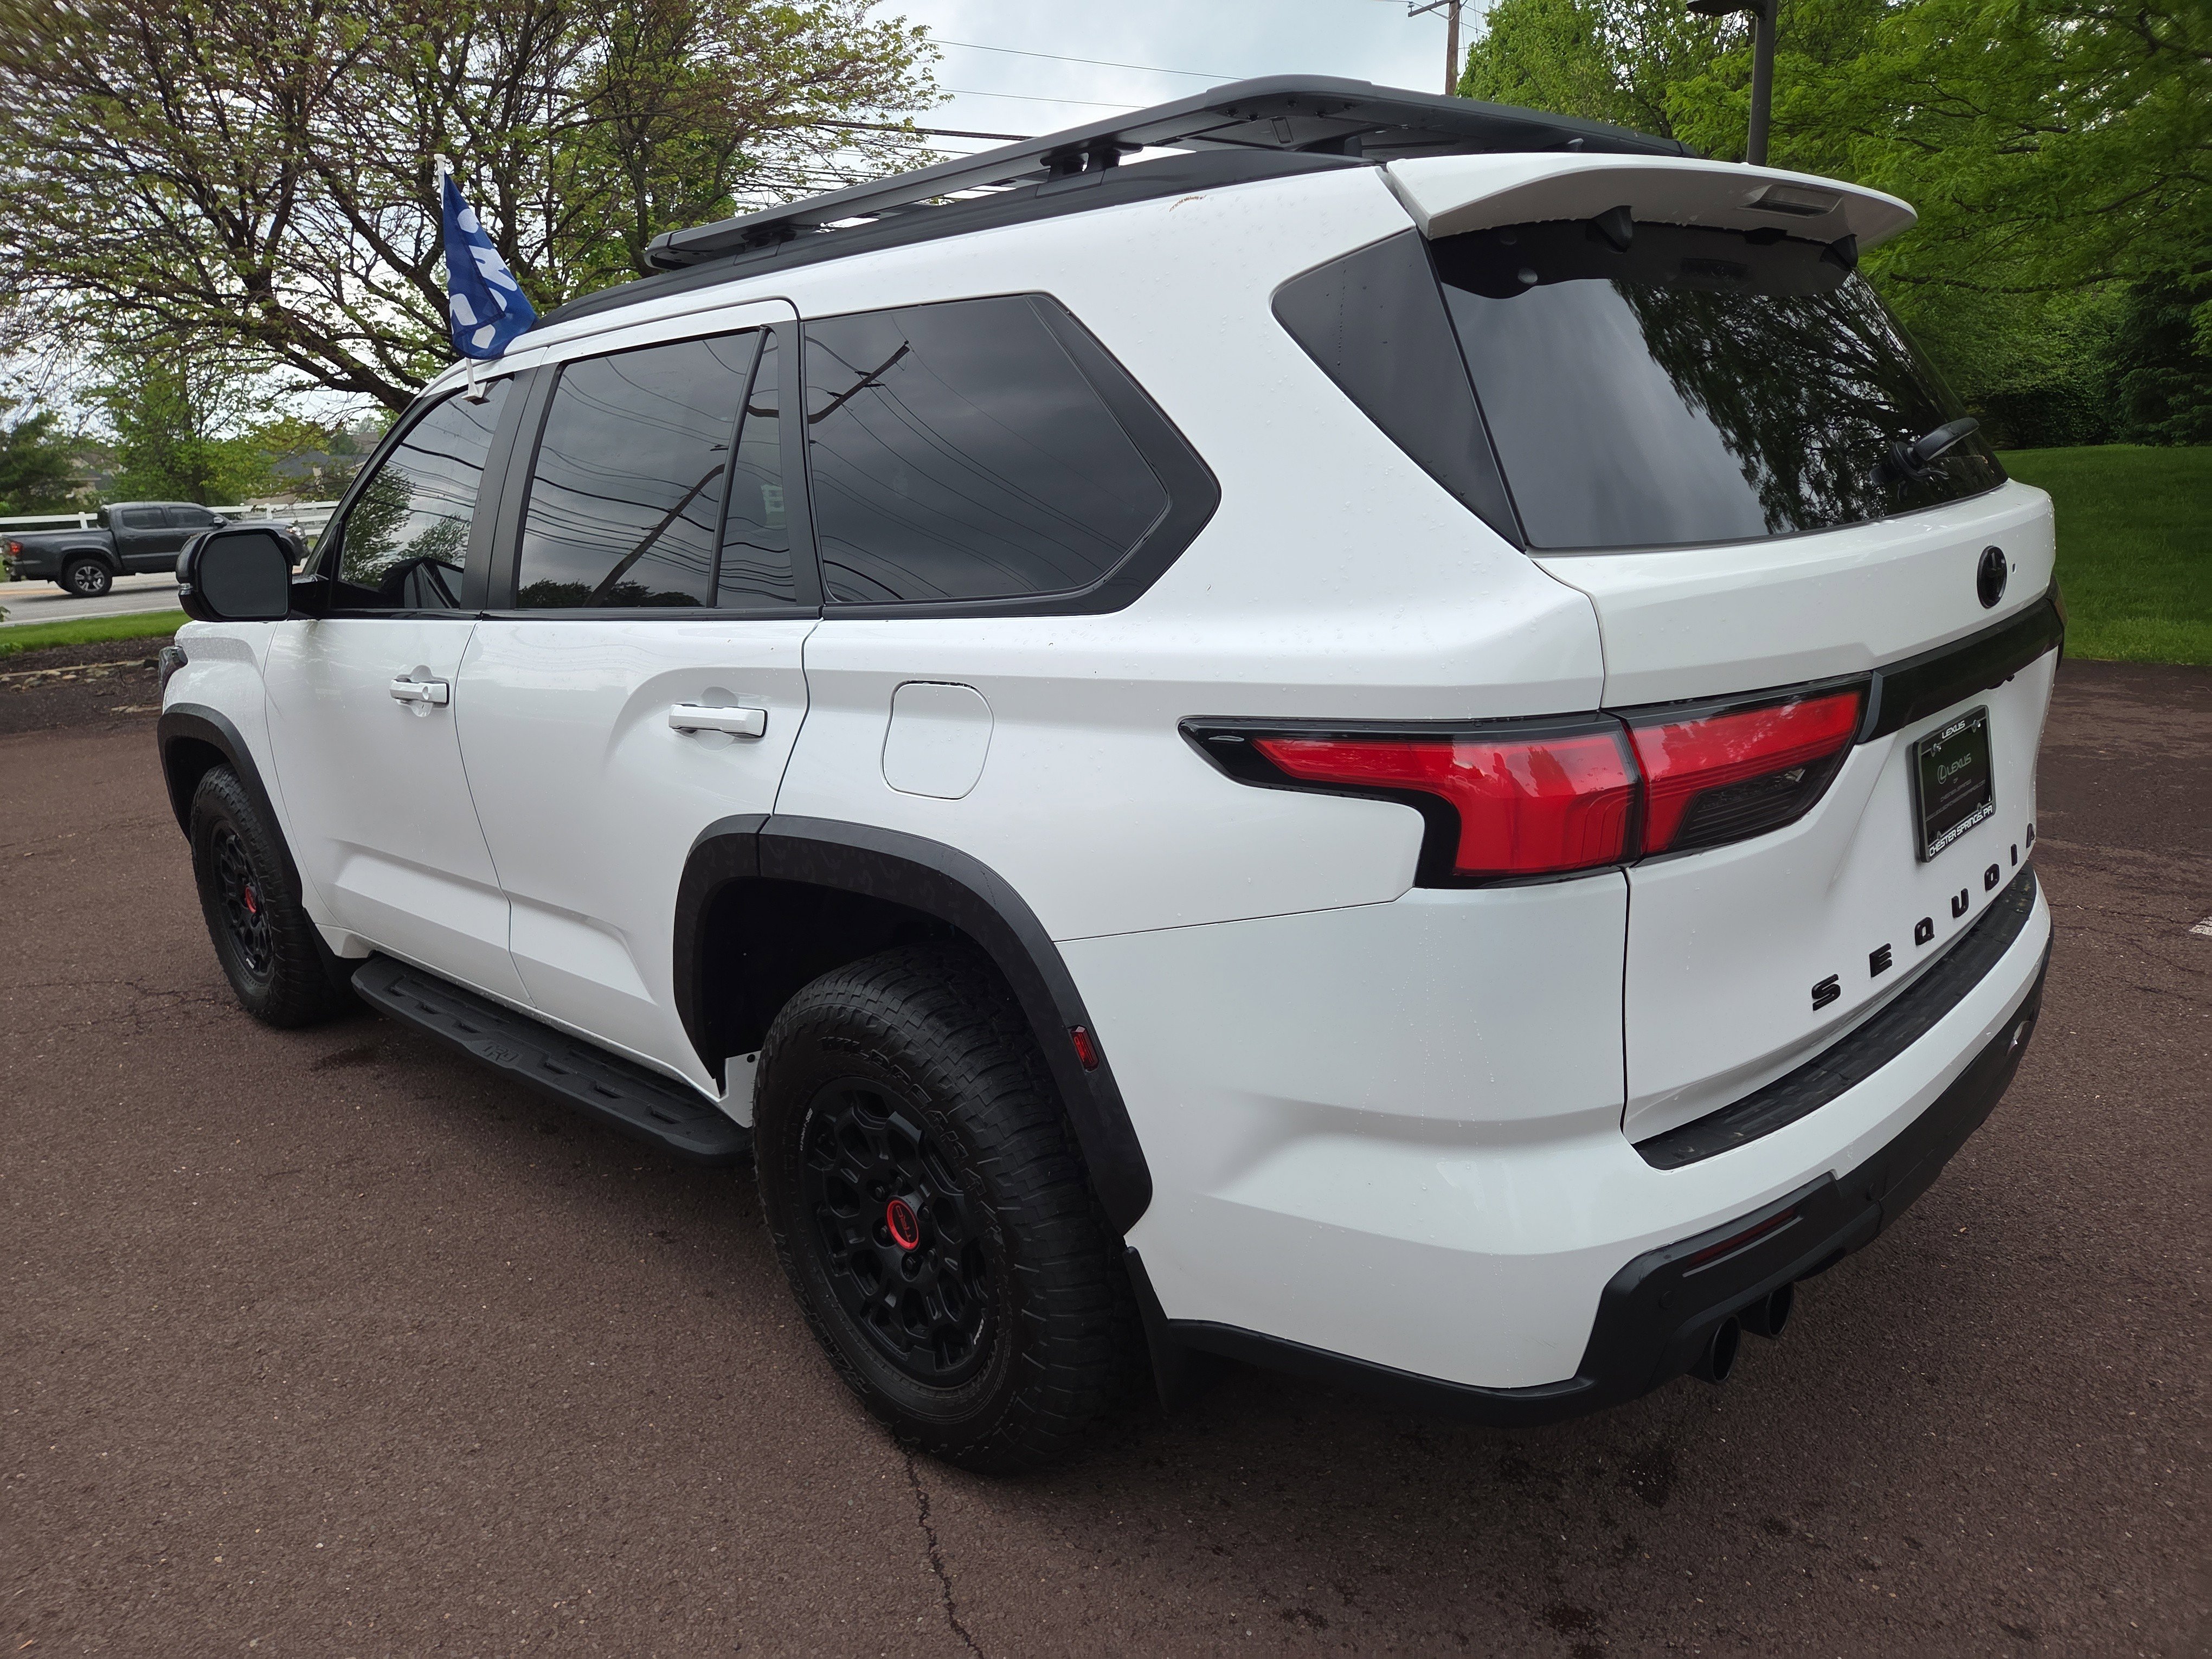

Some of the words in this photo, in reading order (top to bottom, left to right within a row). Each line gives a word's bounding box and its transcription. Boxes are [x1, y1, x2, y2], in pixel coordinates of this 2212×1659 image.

[1941, 720, 1965, 739] LEXUS
[1947, 753, 1972, 775] LEXUS
[1929, 829, 1957, 857] CHESTER
[1983, 805, 1993, 817] PA
[1811, 822, 2035, 1011] SEQUOIA
[482, 1045, 519, 1063] TRD
[895, 1205, 911, 1242] TRD
